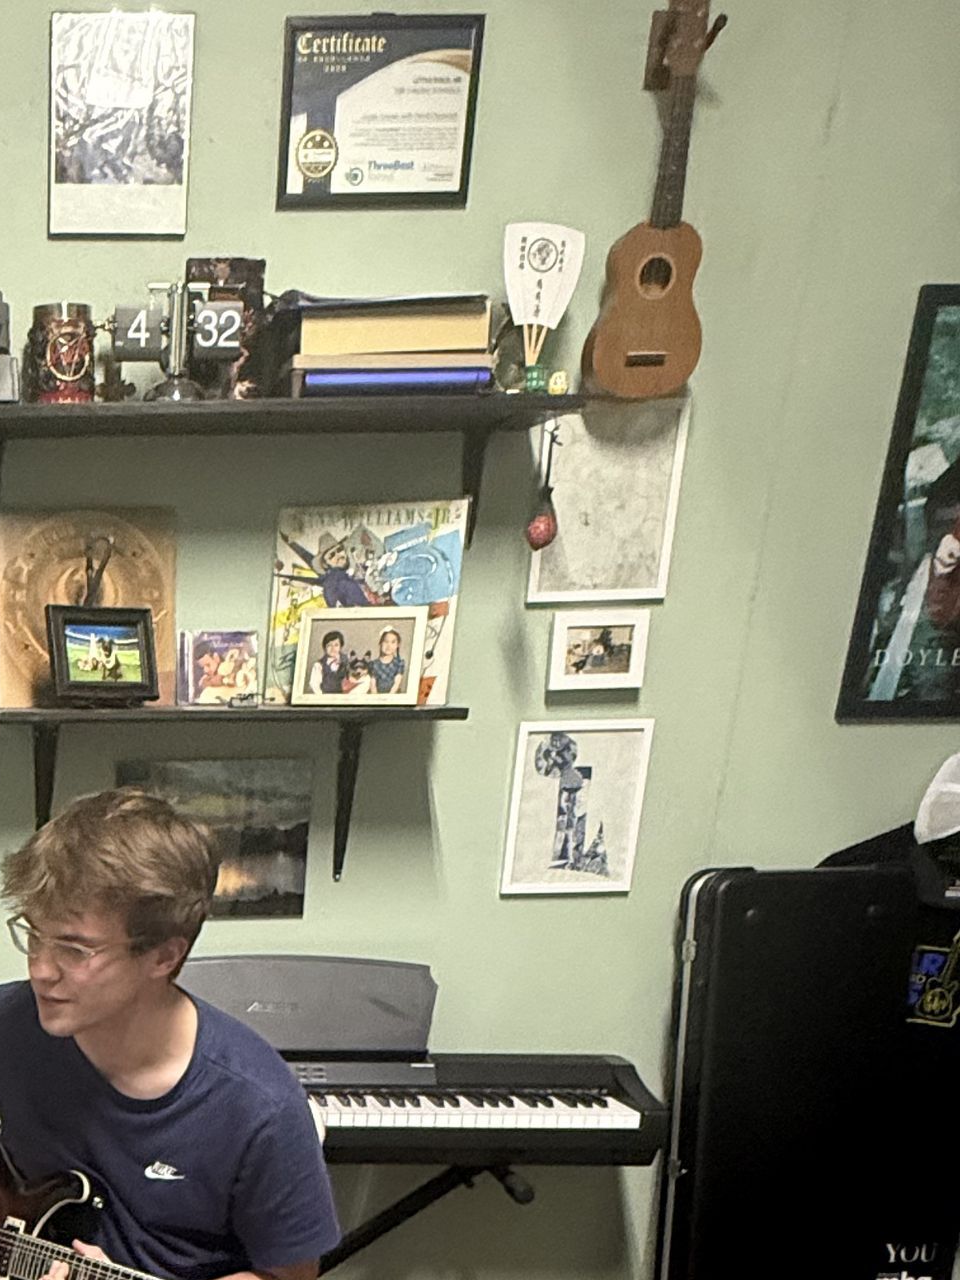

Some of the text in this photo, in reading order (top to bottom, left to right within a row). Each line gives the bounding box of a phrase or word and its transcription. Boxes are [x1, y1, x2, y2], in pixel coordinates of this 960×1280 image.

[297, 31, 387, 54] Certificate
[127, 310, 151, 348] 4
[196, 309, 242, 348] 32
[886, 1243, 938, 1263] YOU
